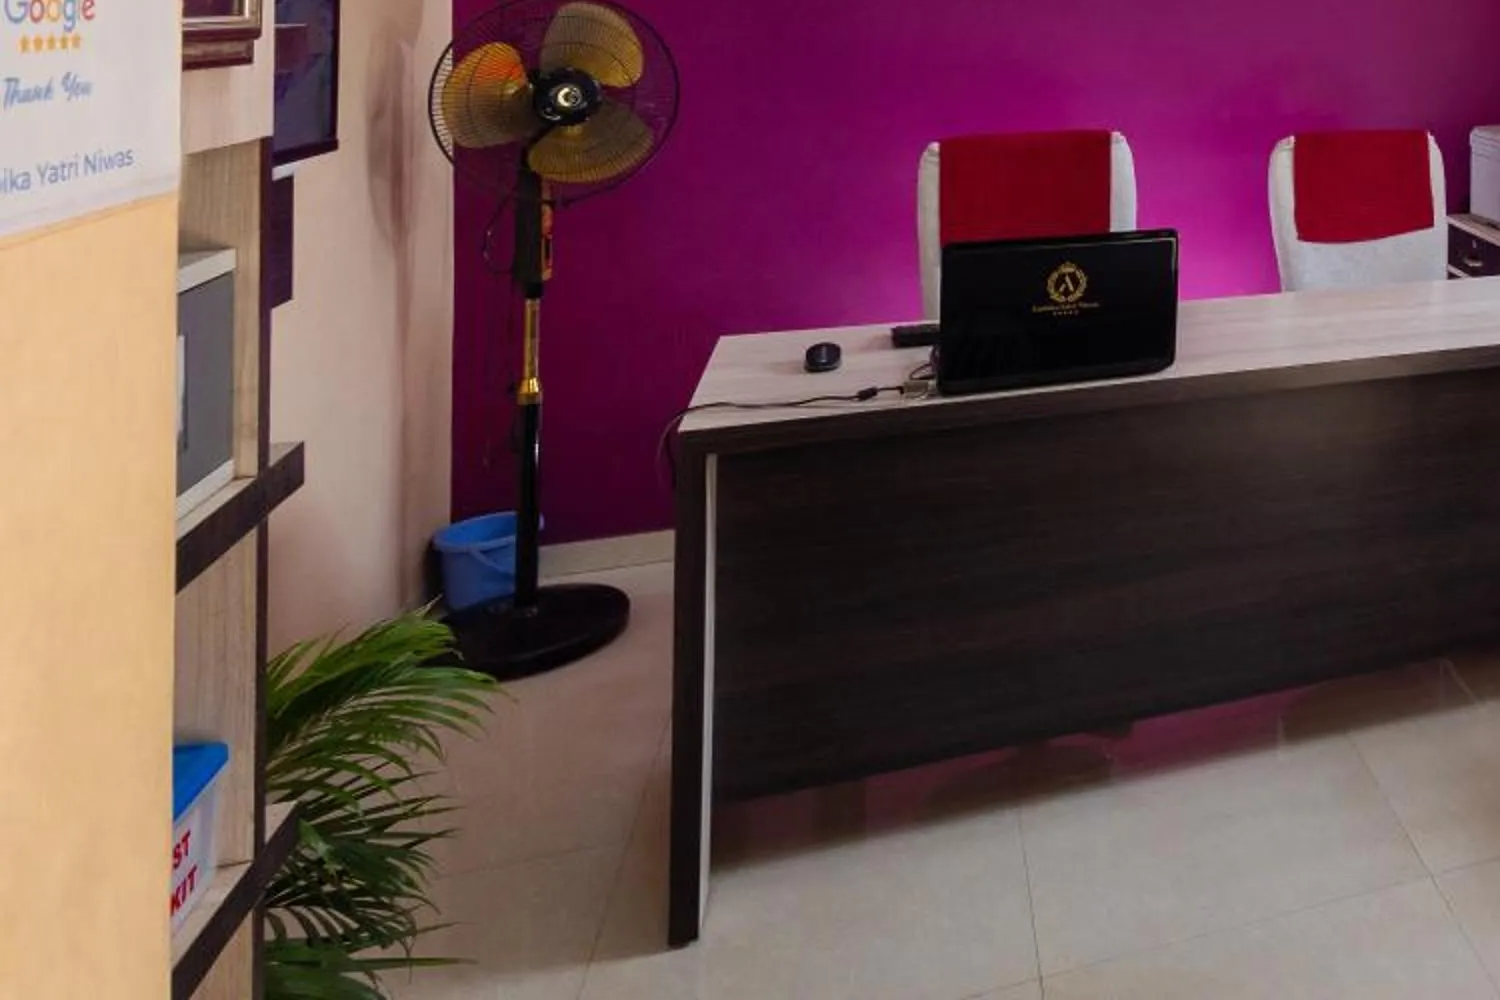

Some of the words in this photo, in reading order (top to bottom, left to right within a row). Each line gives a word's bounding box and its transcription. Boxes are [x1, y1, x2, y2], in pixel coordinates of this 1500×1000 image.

[3, 77, 54, 109] Thank
[61, 71, 93, 101] You
[0, 164, 31, 193] ika
[36, 151, 79, 186] Yatri
[83, 148, 135, 177] Niwas
